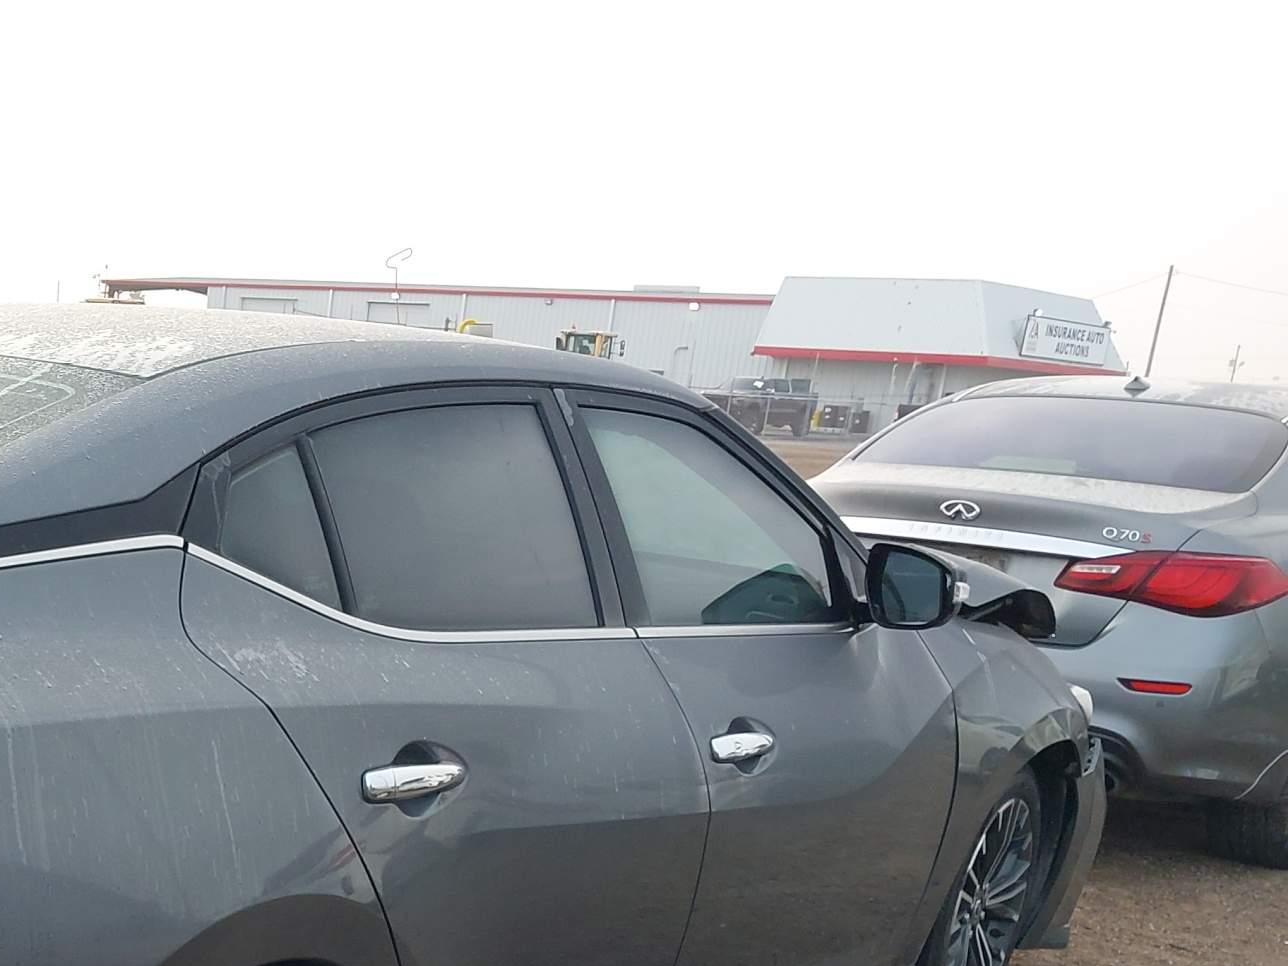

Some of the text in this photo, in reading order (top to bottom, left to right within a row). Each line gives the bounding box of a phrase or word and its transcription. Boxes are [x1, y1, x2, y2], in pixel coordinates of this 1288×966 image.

[1045, 324, 1086, 342] INSURANCE
[1085, 330, 1105, 345] AUTO
[1055, 342, 1090, 358] AUCTIONS
